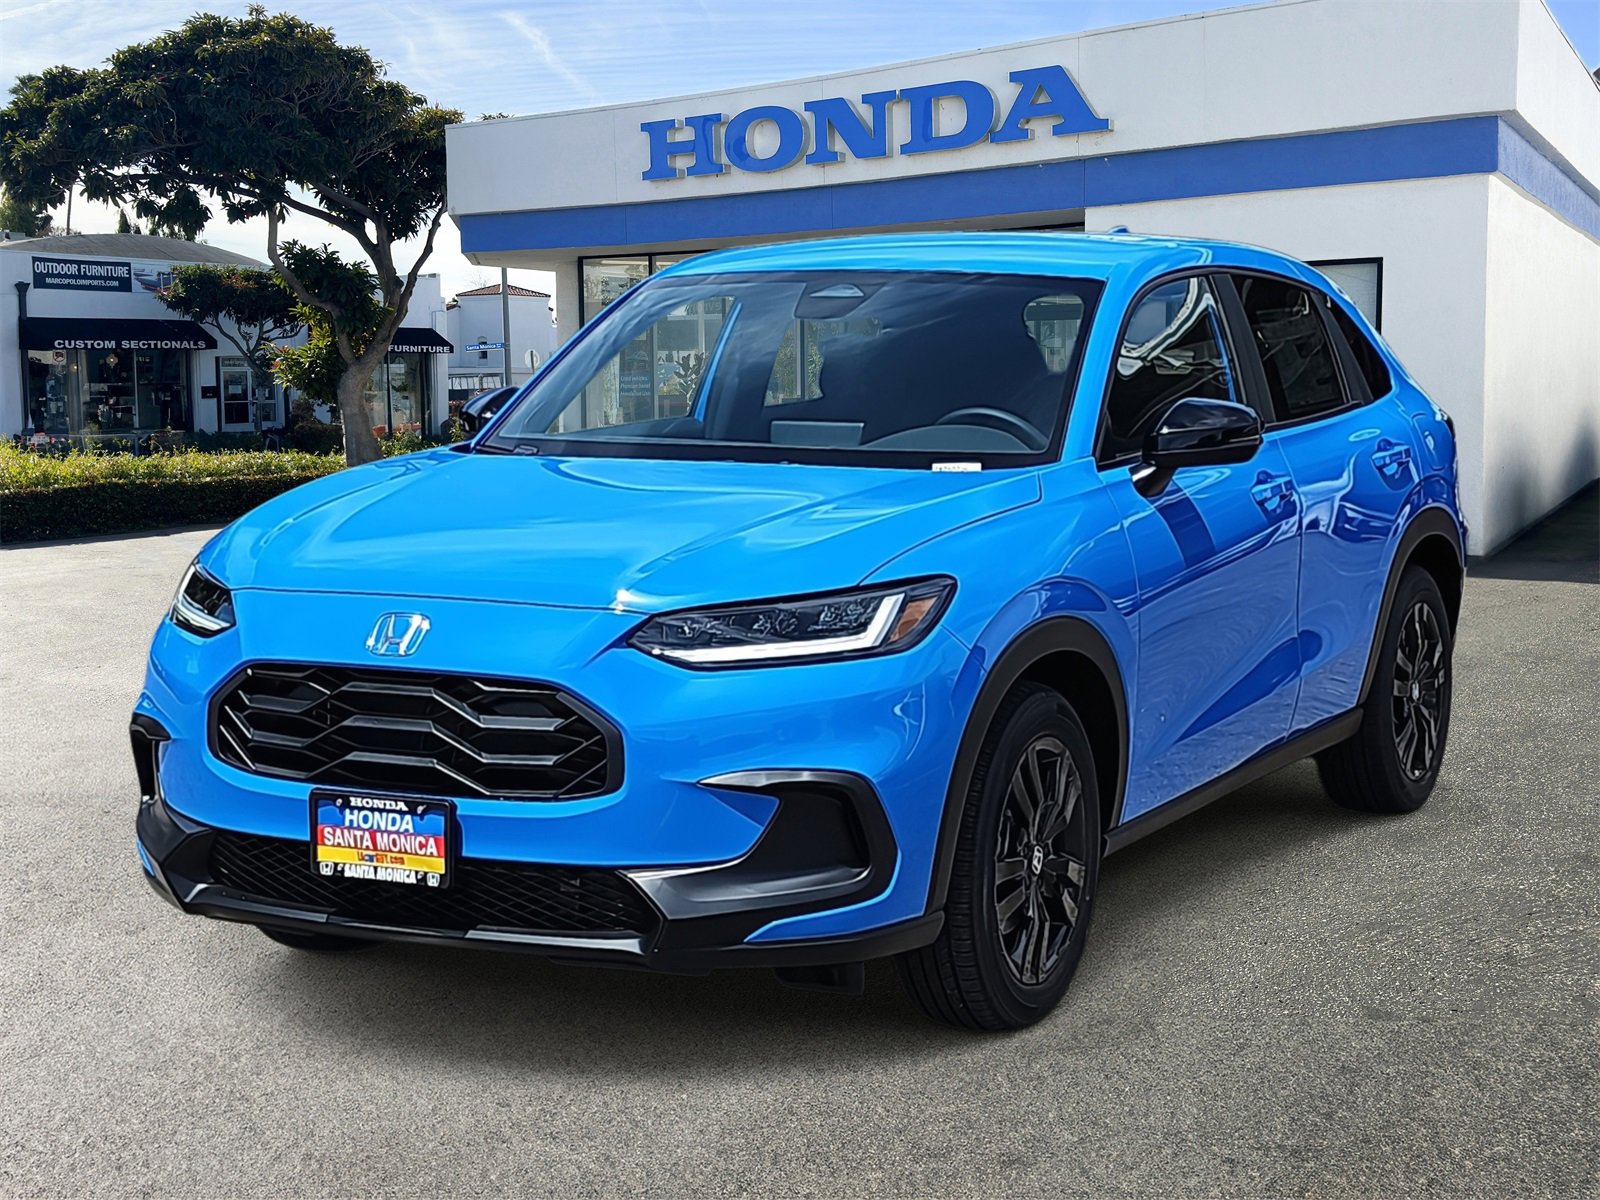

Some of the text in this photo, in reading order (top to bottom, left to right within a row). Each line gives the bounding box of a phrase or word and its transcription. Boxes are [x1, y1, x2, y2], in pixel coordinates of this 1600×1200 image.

[640, 65, 1113, 181] HONDA
[34, 261, 130, 278] OUTDOOR FURNITURE
[45, 277, 119, 287] MARCOPOLOIMPORTS.COM
[54, 339, 206, 349] CUSTOM SECTIONALS
[388, 344, 451, 353] FURNITURE
[349, 796, 409, 812] HONDA
[344, 808, 414, 833] HONDA
[323, 827, 439, 857] SANTA MONICA
[344, 863, 417, 884] SANTA MONICA
